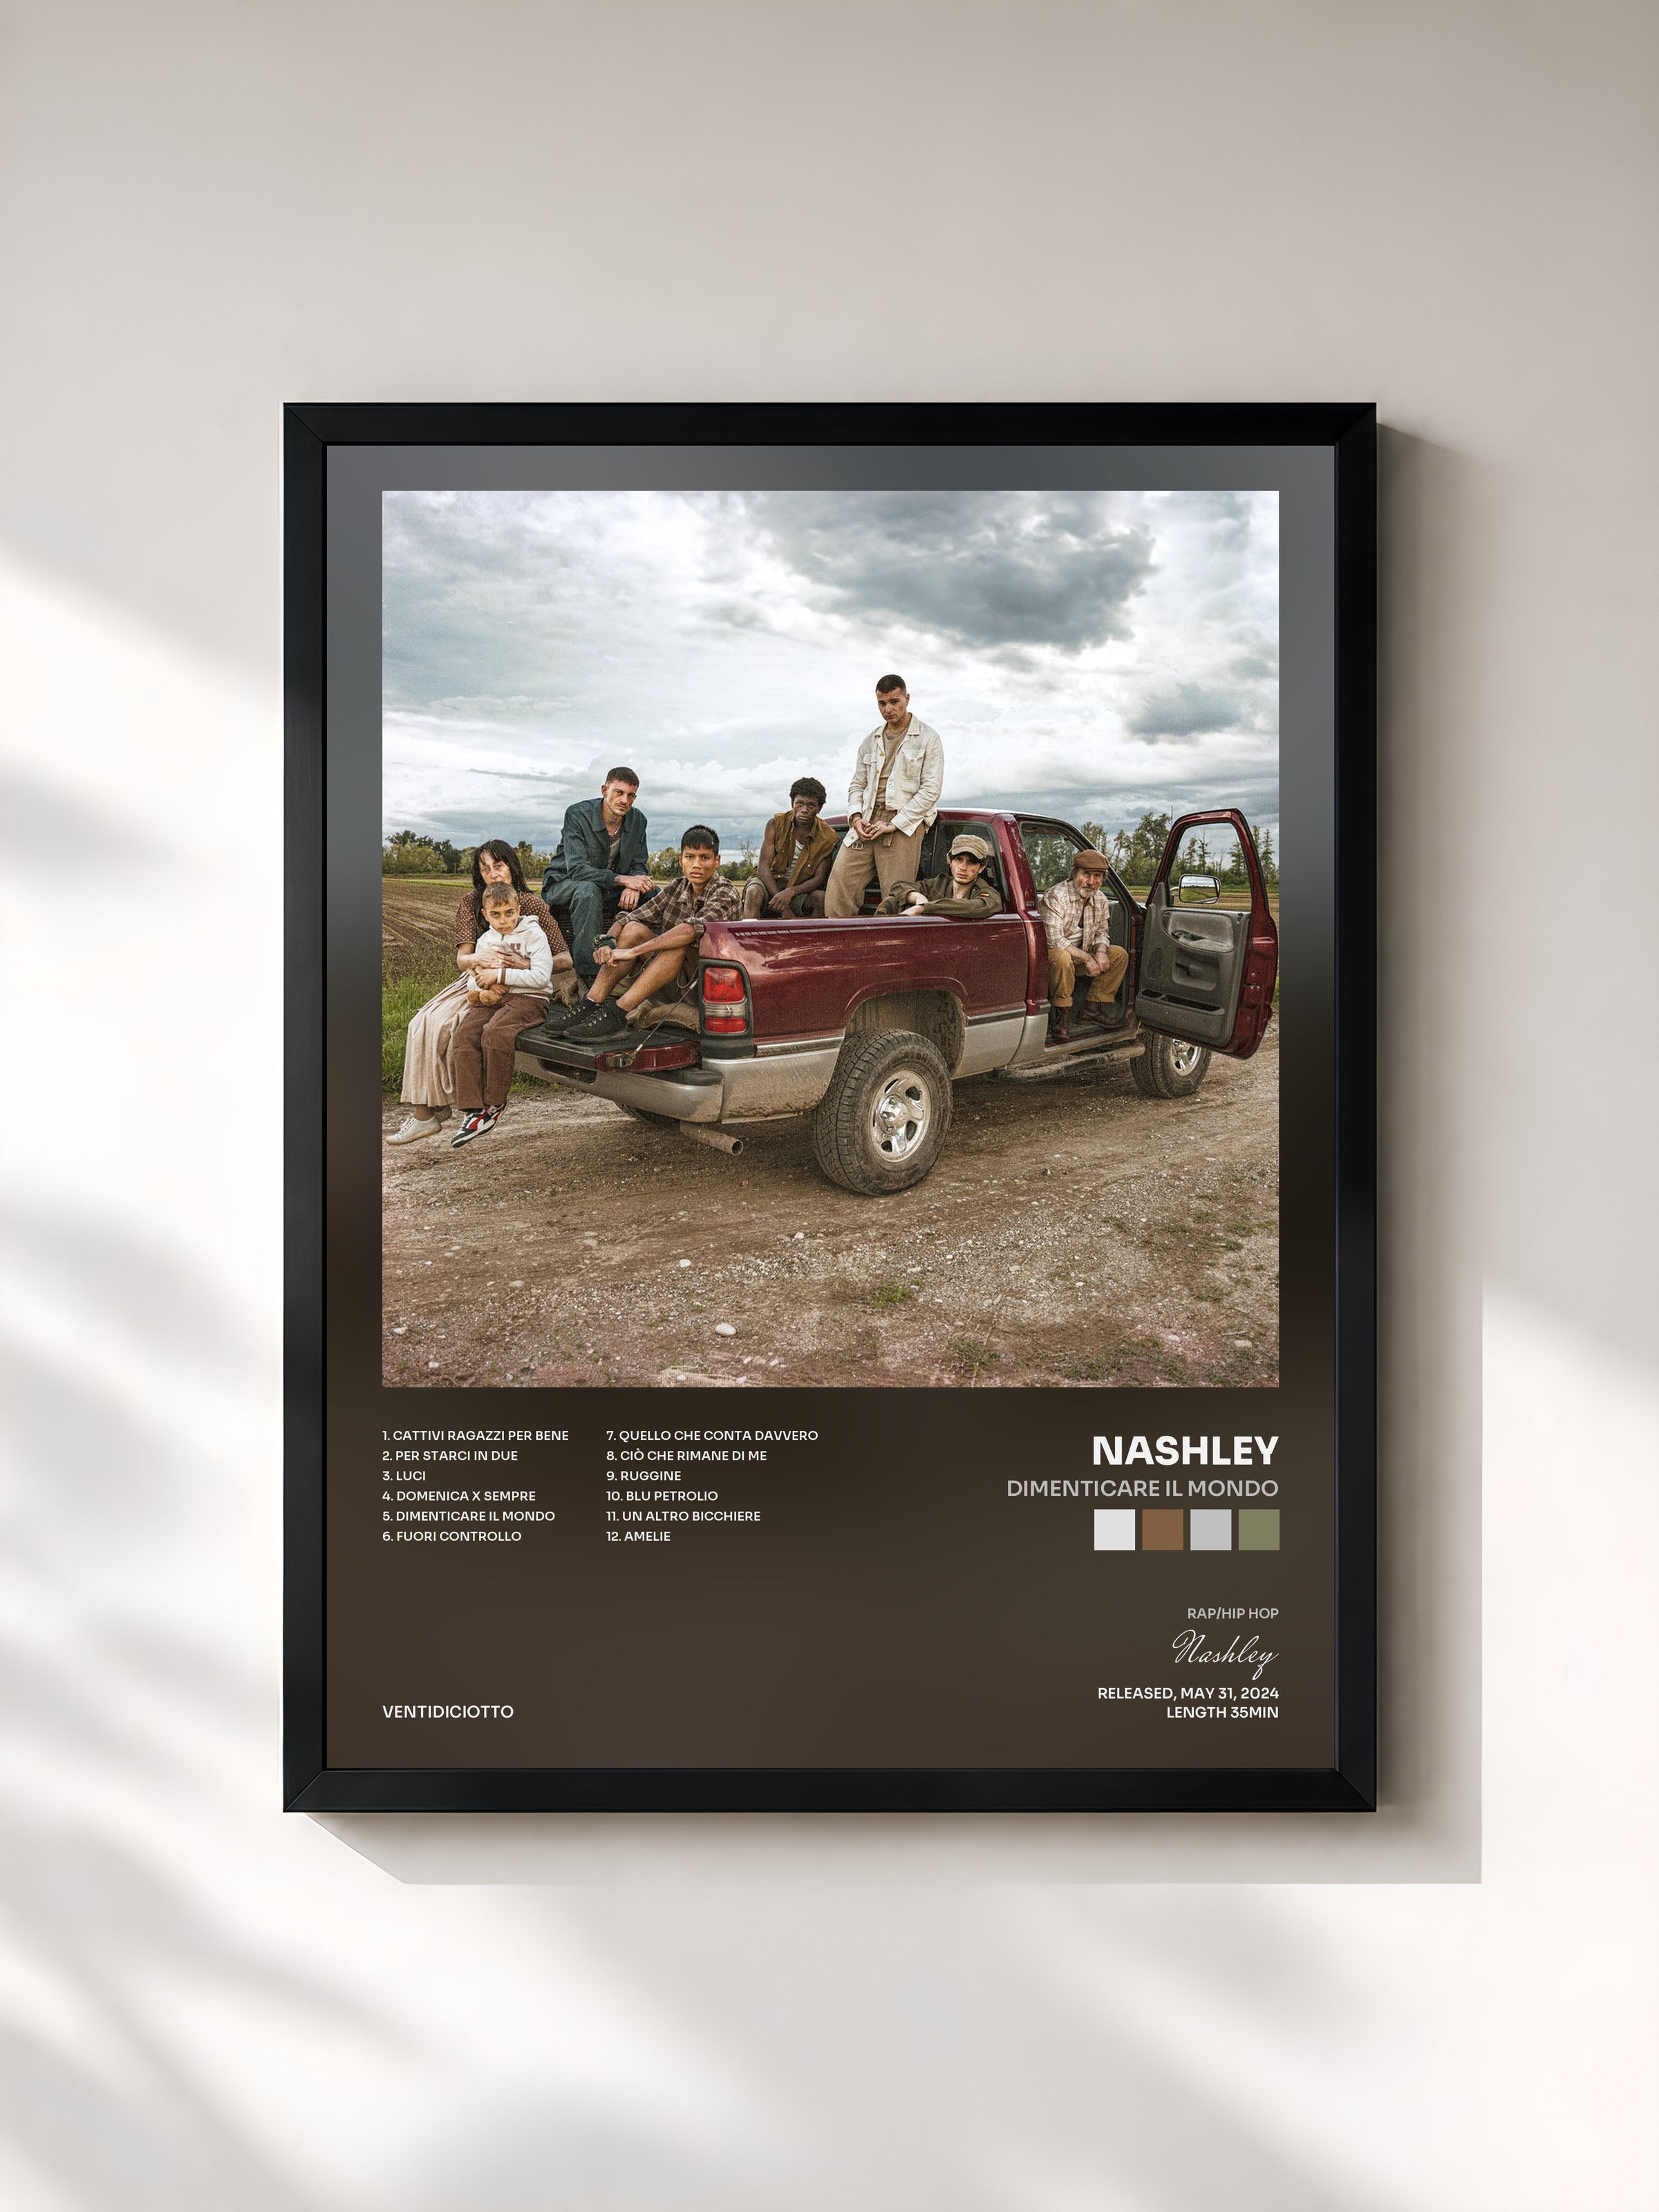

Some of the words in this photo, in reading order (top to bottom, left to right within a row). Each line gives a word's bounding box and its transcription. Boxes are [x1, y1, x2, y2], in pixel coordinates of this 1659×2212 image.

[382, 1430, 391, 1441] 1.
[393, 1430, 444, 1441] CATTIVI
[447, 1430, 505, 1441] RAGAZZI
[508, 1430, 532, 1441] PER
[536, 1430, 569, 1441] BENE
[606, 1430, 617, 1441] 7.
[619, 1430, 671, 1443] QUELLO
[674, 1430, 701, 1441] CHE
[704, 1430, 752, 1441] CONTA
[755, 1430, 818, 1441] DAVVERO
[382, 1450, 393, 1461] 2.
[395, 1450, 420, 1461] PER
[422, 1450, 471, 1461] STARCI
[474, 1450, 488, 1461] IN
[491, 1450, 518, 1461] DUE
[606, 1450, 618, 1461] 8.
[620, 1447, 644, 1461] CIÒ
[647, 1450, 674, 1461] CHE
[677, 1450, 729, 1461] RIMANE
[732, 1450, 744, 1461] DI
[748, 1450, 767, 1461] ME
[1093, 1436, 1279, 1465] NASHLEY
[382, 1470, 393, 1481] 3.
[396, 1470, 426, 1481] LUCI
[606, 1470, 618, 1481] 9.
[621, 1470, 682, 1481] RUGGINE
[1007, 1479, 1160, 1497] DIMENTICARE
[1165, 1480, 1183, 1497] IL
[1188, 1479, 1279, 1497] MONDO
[382, 1490, 394, 1501] 4.
[397, 1490, 469, 1501] DOMENICA
[471, 1490, 481, 1501] X
[483, 1490, 536, 1501] SEMPRE
[606, 1490, 624, 1501] 10.
[626, 1490, 650, 1501] BLU
[654, 1490, 718, 1501] PETROLIO
[382, 1511, 393, 1521] 5.
[396, 1510, 486, 1521] DIMENTICARE
[489, 1510, 500, 1521] IL
[503, 1511, 556, 1521] MONDO
[606, 1511, 619, 1521] 11.
[622, 1510, 642, 1521] UN
[645, 1511, 689, 1521] ALTRO
[692, 1511, 761, 1521] BICCHIERE
[382, 1531, 394, 1541] 6.
[397, 1531, 436, 1541] FUORI
[439, 1531, 522, 1541] CONTROLLO
[606, 1531, 621, 1541] 12.
[624, 1531, 671, 1541] AMELIE
[1188, 1606, 1246, 1620] RAP/HIP
[1248, 1607, 1279, 1620] HOP
[1172, 1629, 1279, 1680] Nashley
[1098, 1687, 1177, 1702] RELEASED,
[1181, 1687, 1215, 1699] MAY
[1218, 1687, 1237, 1702] 31,
[1241, 1687, 1280, 1700] 2024
[382, 1705, 514, 1718] VENTIDICIOTTO
[1167, 1706, 1227, 1718] LENGTH
[1230, 1706, 1279, 1718] 35MIN
